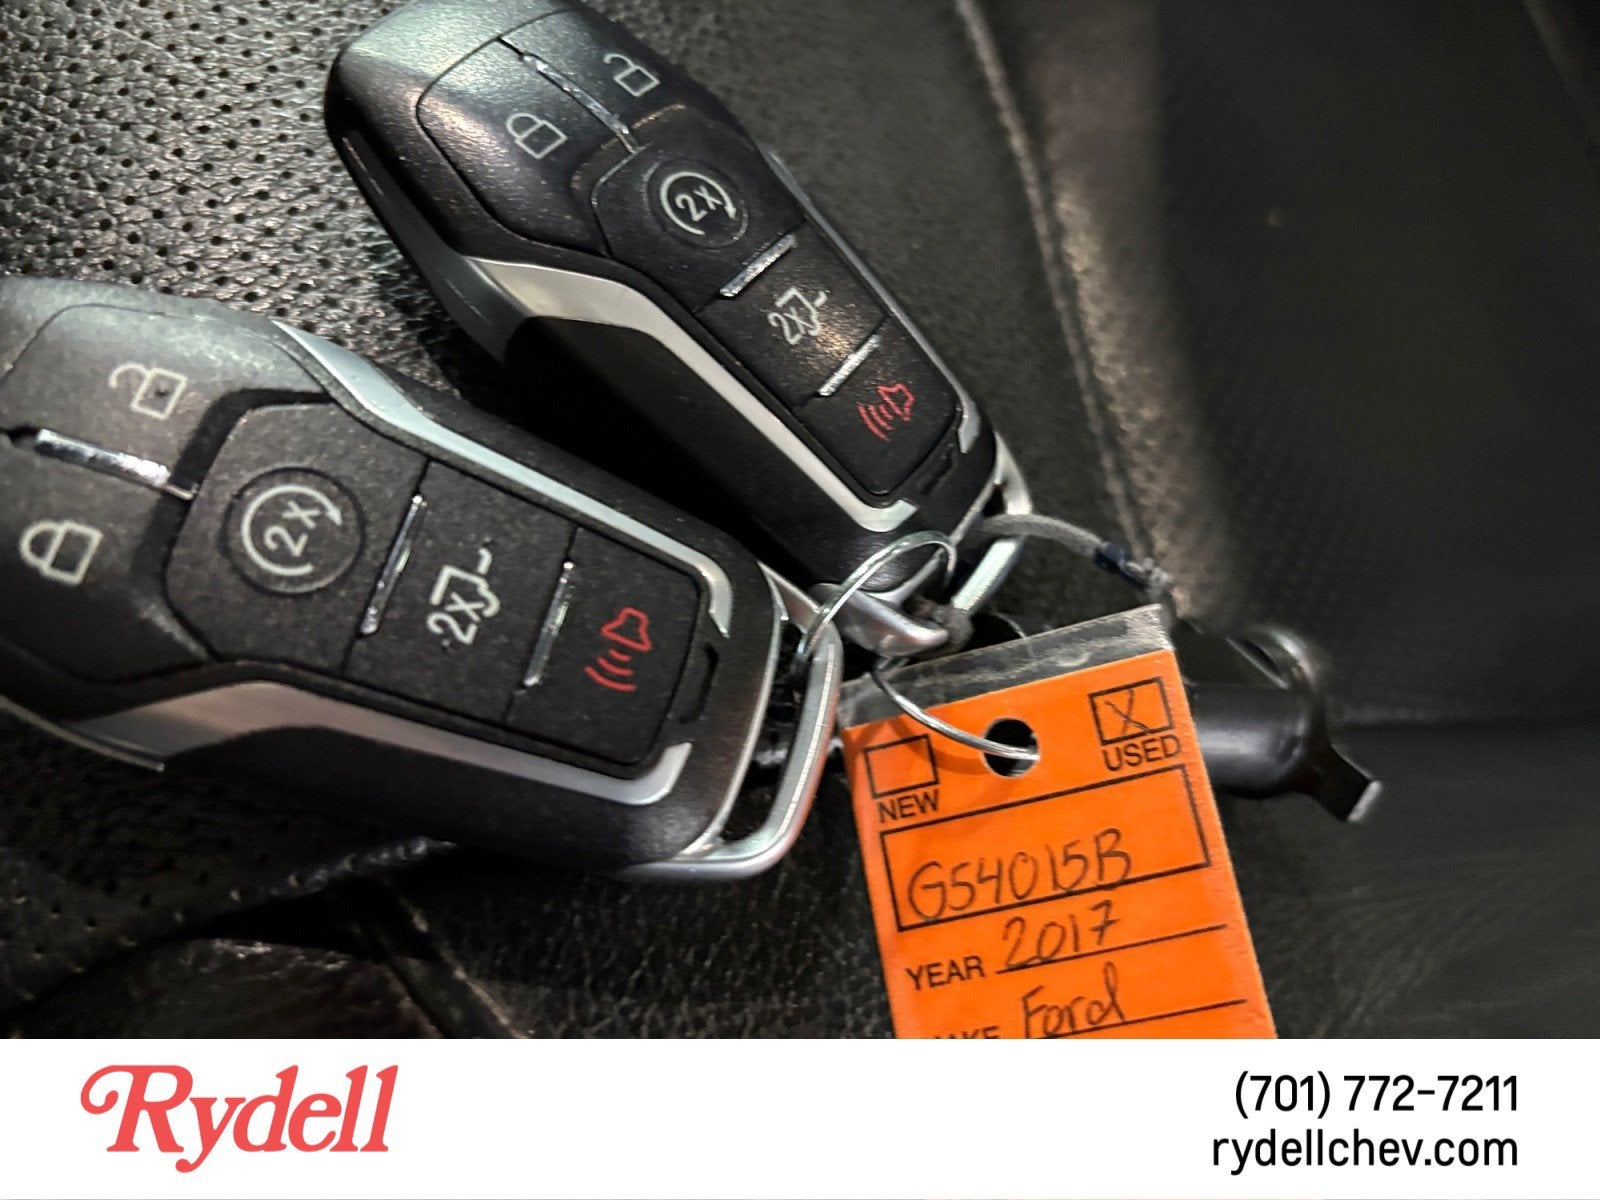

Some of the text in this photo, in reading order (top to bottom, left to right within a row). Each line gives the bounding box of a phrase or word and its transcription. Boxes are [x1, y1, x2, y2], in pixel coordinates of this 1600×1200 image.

[1102, 734, 1182, 771] USED
[879, 789, 940, 823] NEW
[905, 899, 1121, 991] YEAR 2017
[1020, 961, 1126, 1039] Ford
